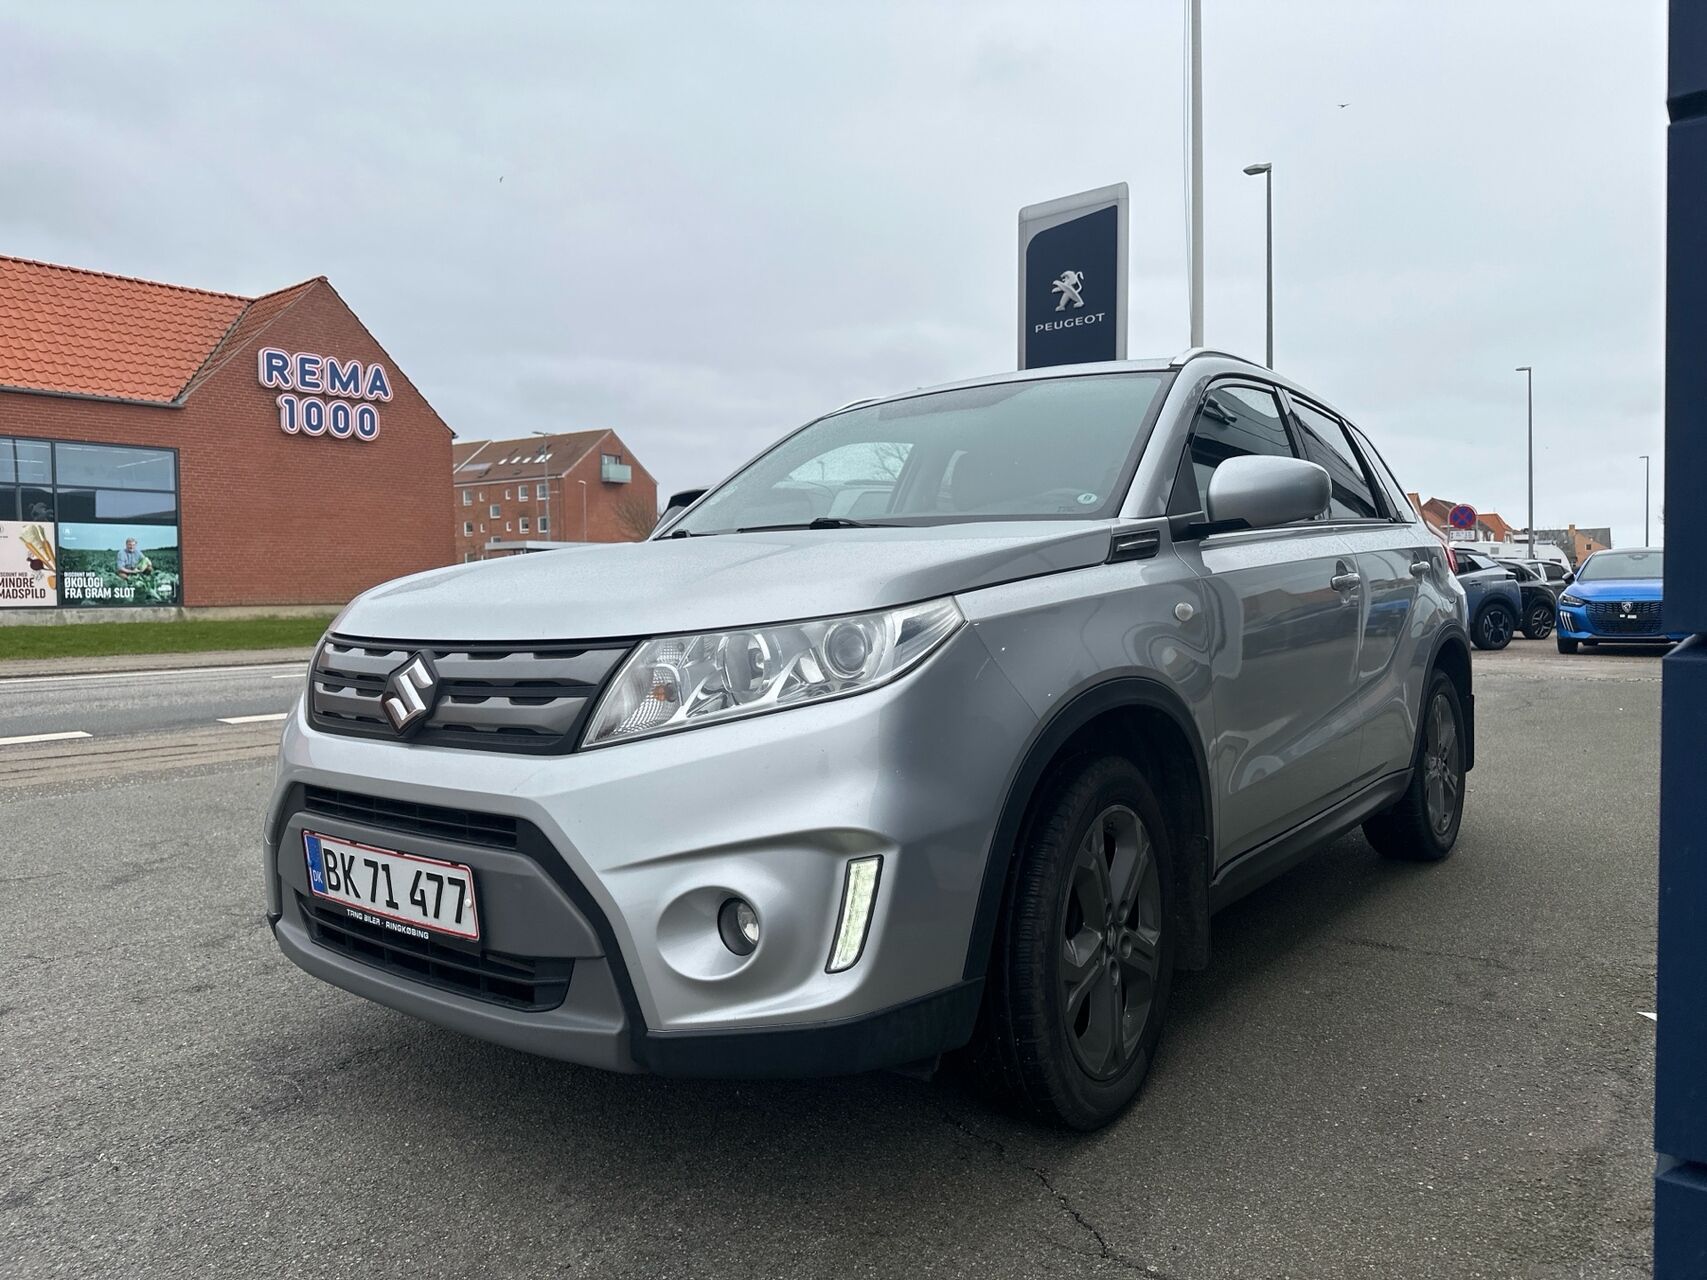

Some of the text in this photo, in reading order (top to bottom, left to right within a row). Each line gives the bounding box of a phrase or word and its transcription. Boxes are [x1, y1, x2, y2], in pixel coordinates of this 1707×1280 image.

[1034, 312, 1105, 333] PEUGEOT
[258, 347, 394, 403] REMA
[276, 393, 381, 442] 1000
[64, 577, 104, 588] ØKOLOGI
[65, 587, 136, 599] FRA GRAM SLOT
[312, 869, 323, 884] DK
[323, 847, 466, 924] BK 71 477
[363, 915, 381, 926] BILER
[385, 921, 430, 940] RINGKØBING
